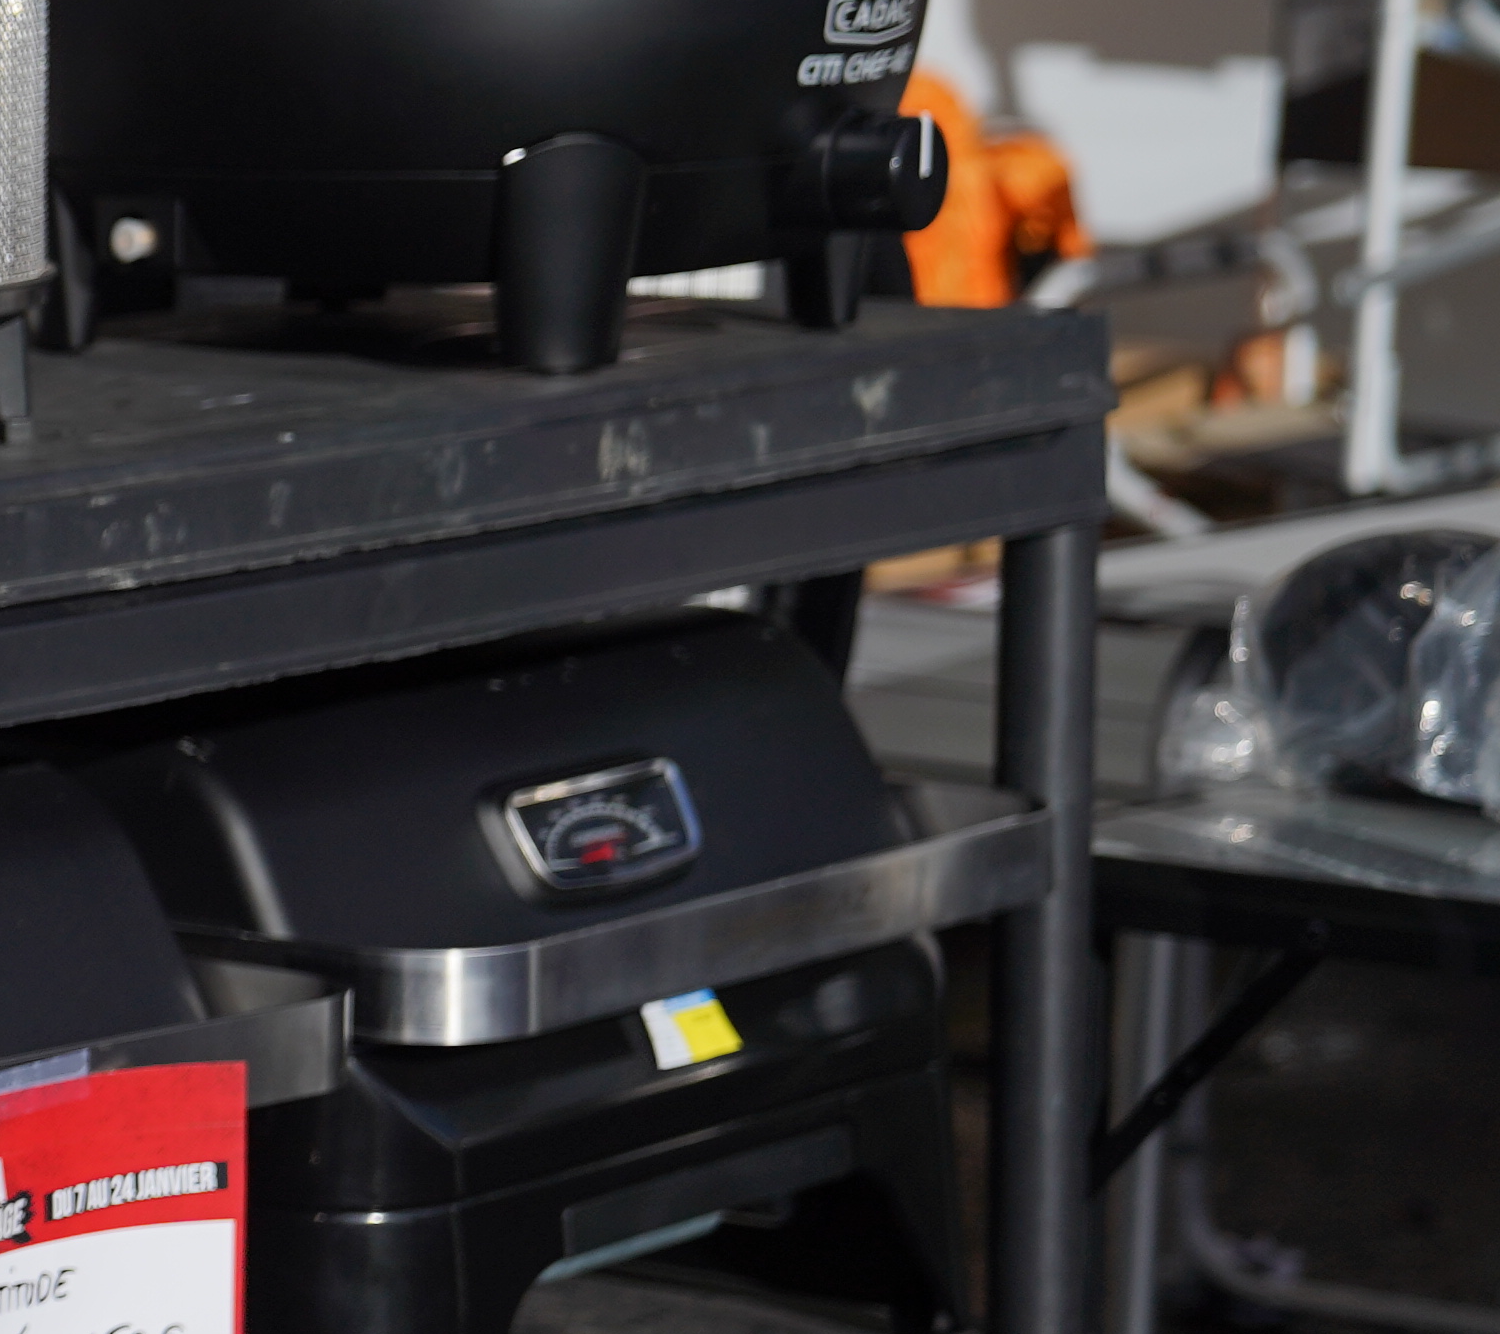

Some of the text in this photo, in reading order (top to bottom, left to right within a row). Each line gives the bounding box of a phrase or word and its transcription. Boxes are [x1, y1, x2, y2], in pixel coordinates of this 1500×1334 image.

[52, 1160, 219, 1221] DU 7 AU 24 JANVIER
